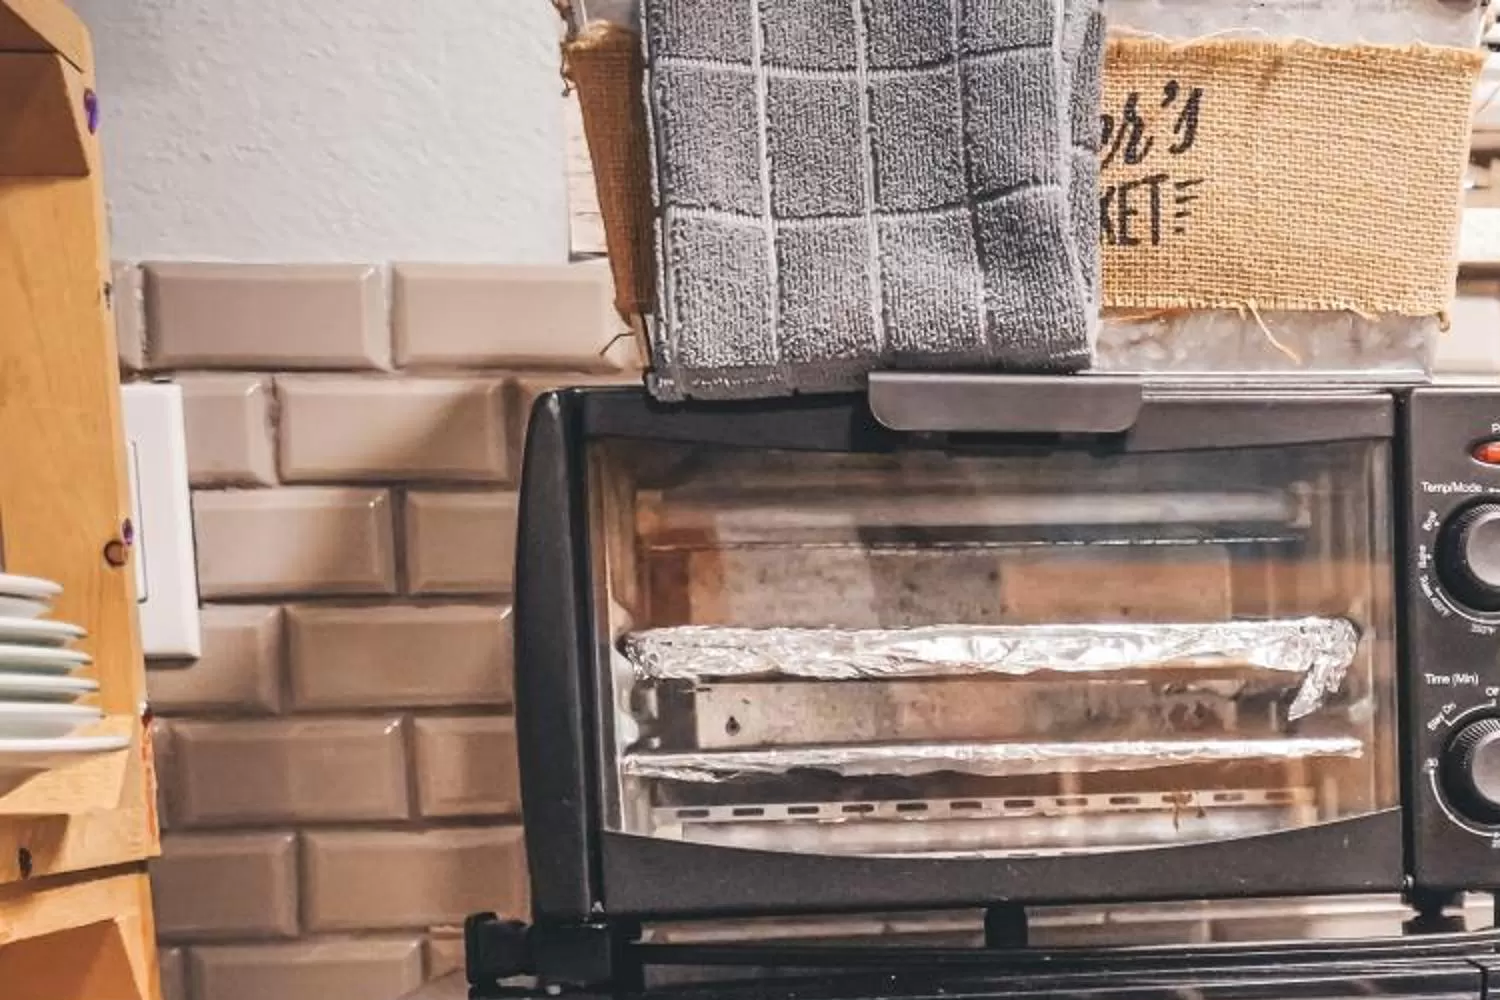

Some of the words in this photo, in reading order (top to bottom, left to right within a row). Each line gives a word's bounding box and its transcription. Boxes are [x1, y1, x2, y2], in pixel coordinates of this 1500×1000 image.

[1421, 481, 1483, 494] Temp/Mode
[1424, 673, 1450, 685] Time
[1452, 672, 1479, 687] (Min)
